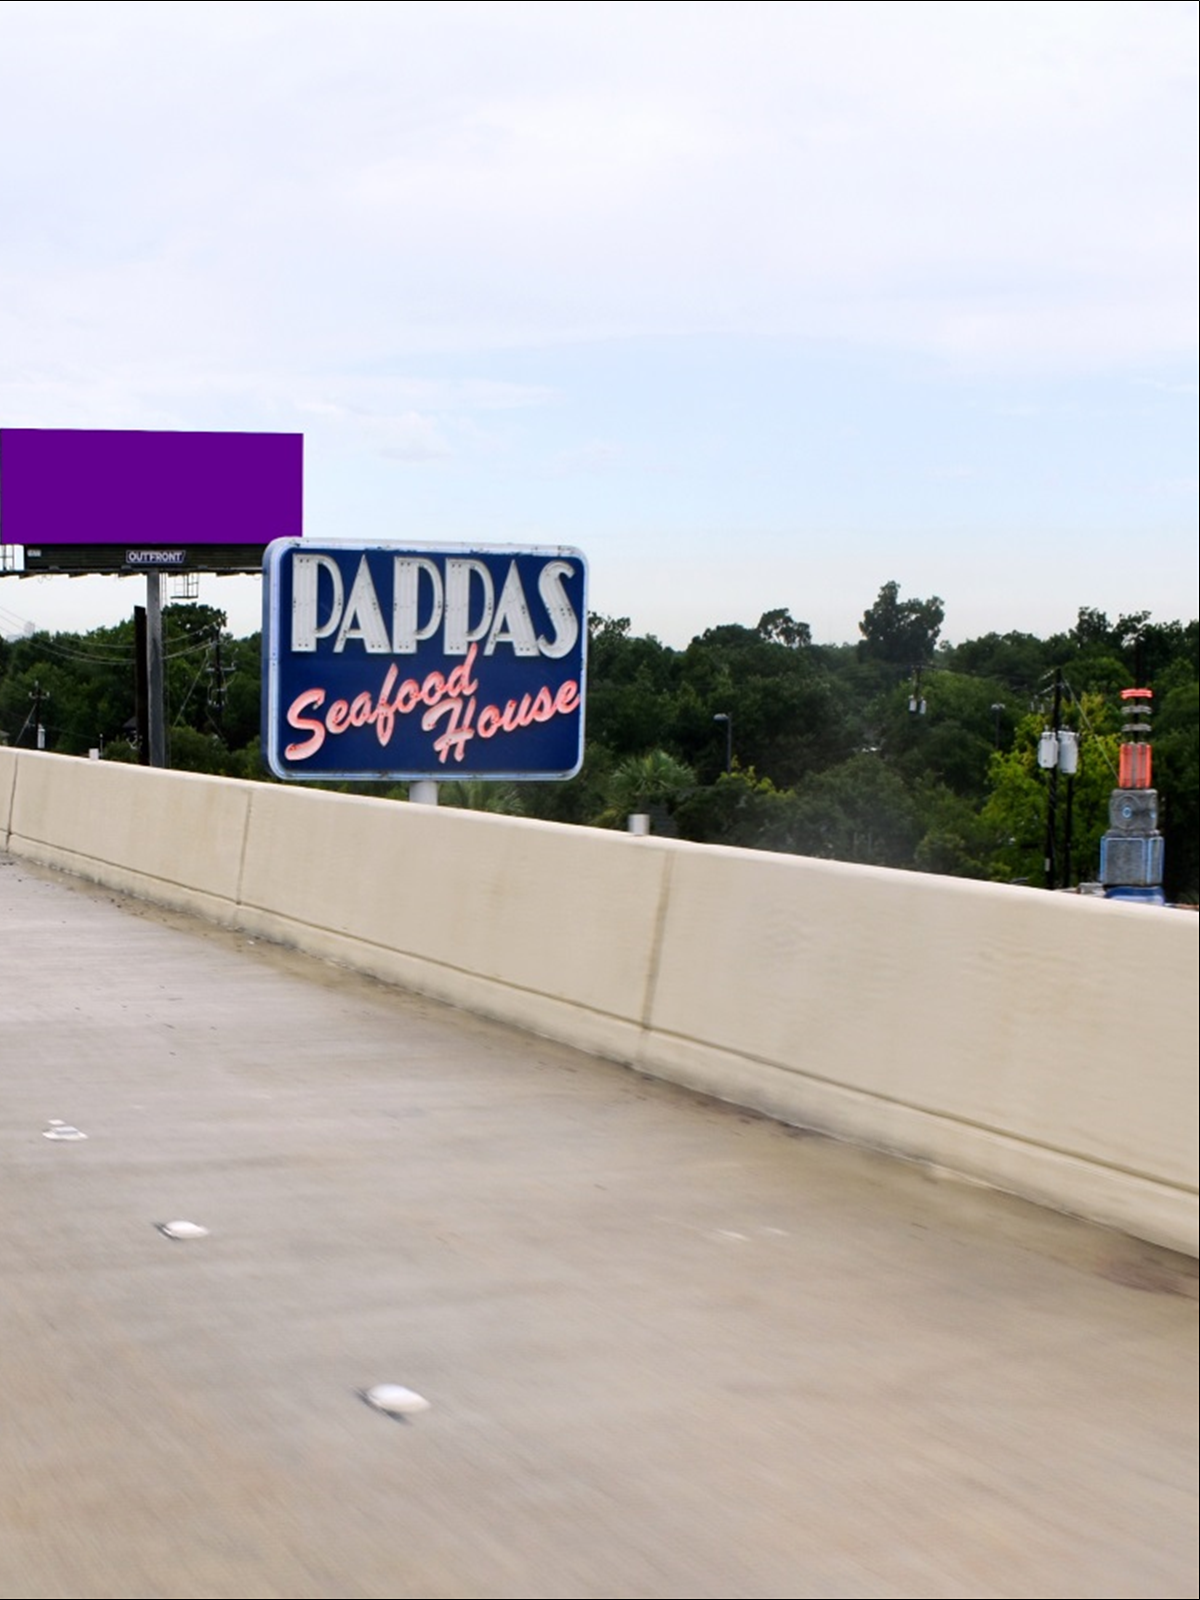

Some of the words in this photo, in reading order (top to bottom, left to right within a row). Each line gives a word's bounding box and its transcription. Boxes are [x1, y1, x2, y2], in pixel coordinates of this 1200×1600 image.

[128, 551, 183, 563] OUTFRONT
[291, 553, 579, 659] PAPPAS
[284, 641, 478, 761] Seafood
[421, 679, 580, 764] House
